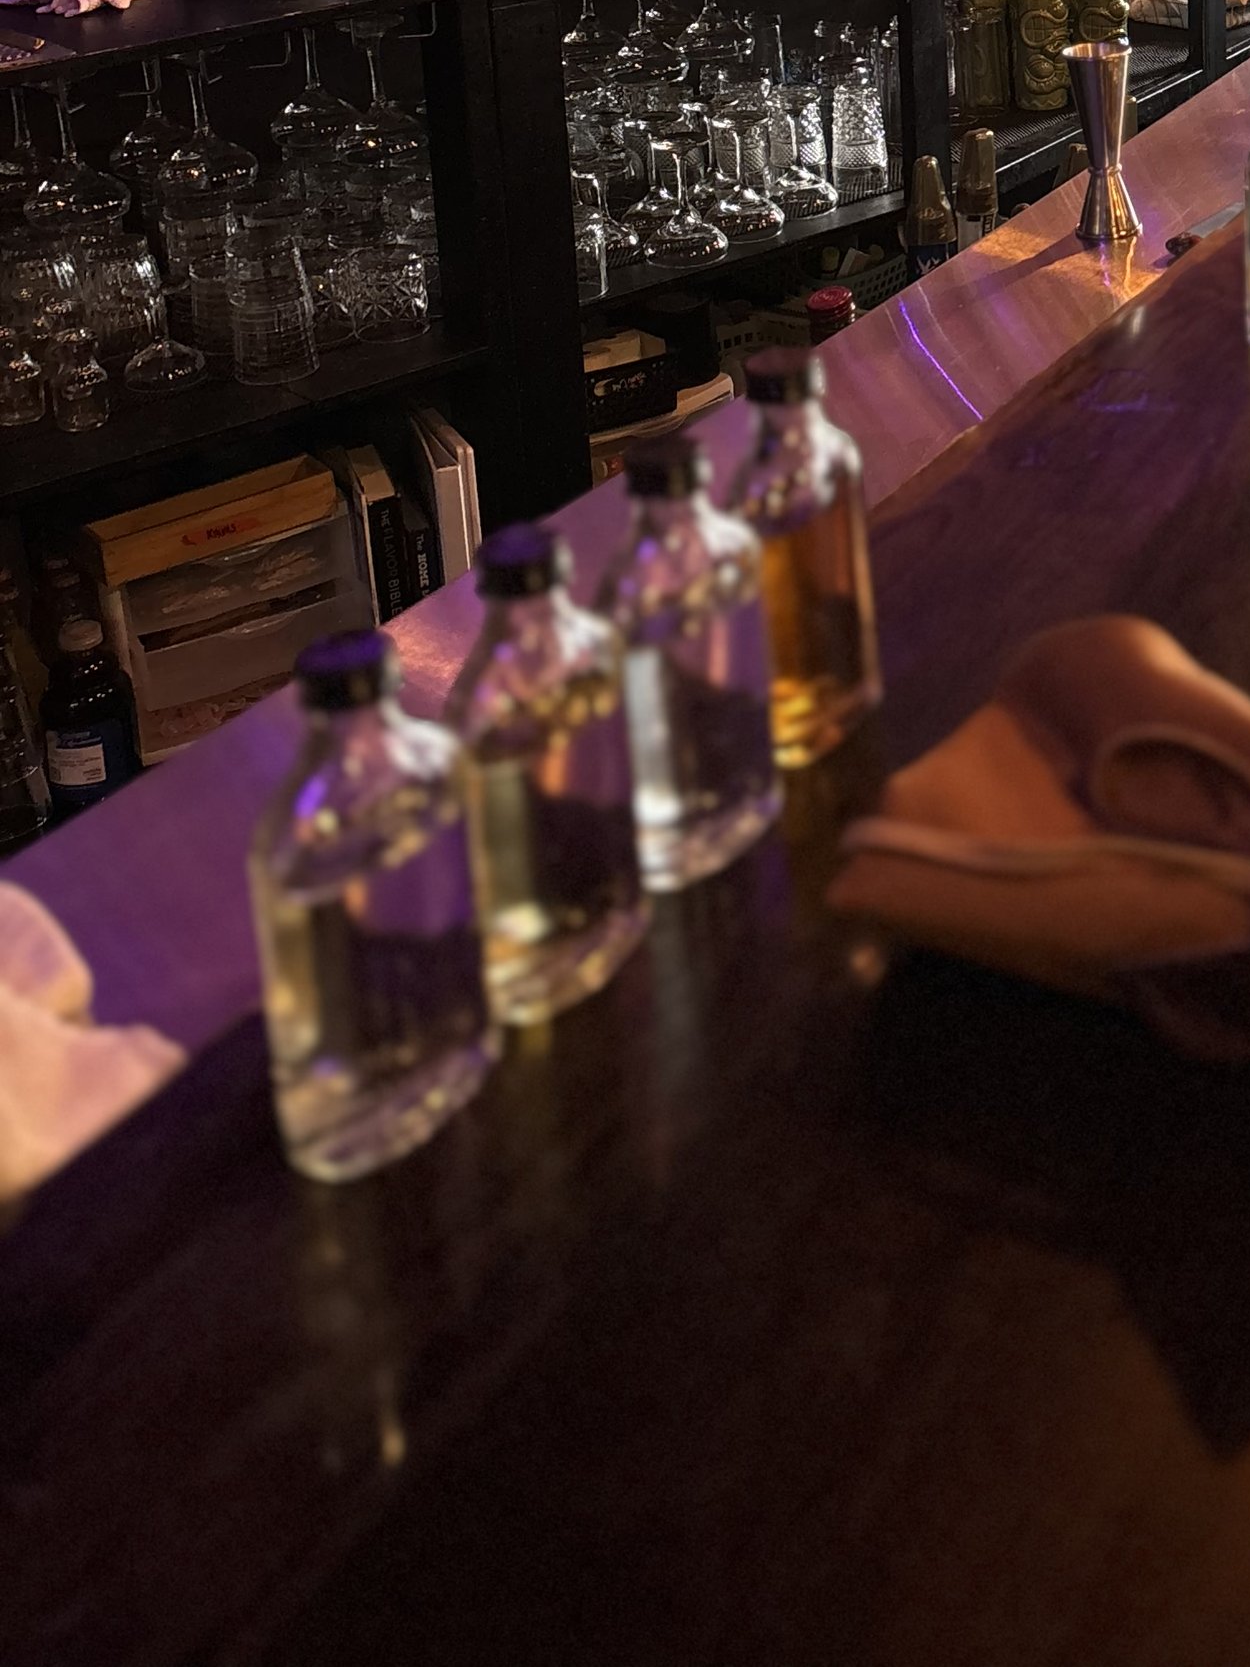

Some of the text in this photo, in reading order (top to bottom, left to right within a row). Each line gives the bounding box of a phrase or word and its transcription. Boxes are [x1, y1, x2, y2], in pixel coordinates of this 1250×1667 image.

[382, 529, 399, 577] FLAVOR
[417, 553, 430, 588] HOME
[387, 578, 403, 615] BIBLE
